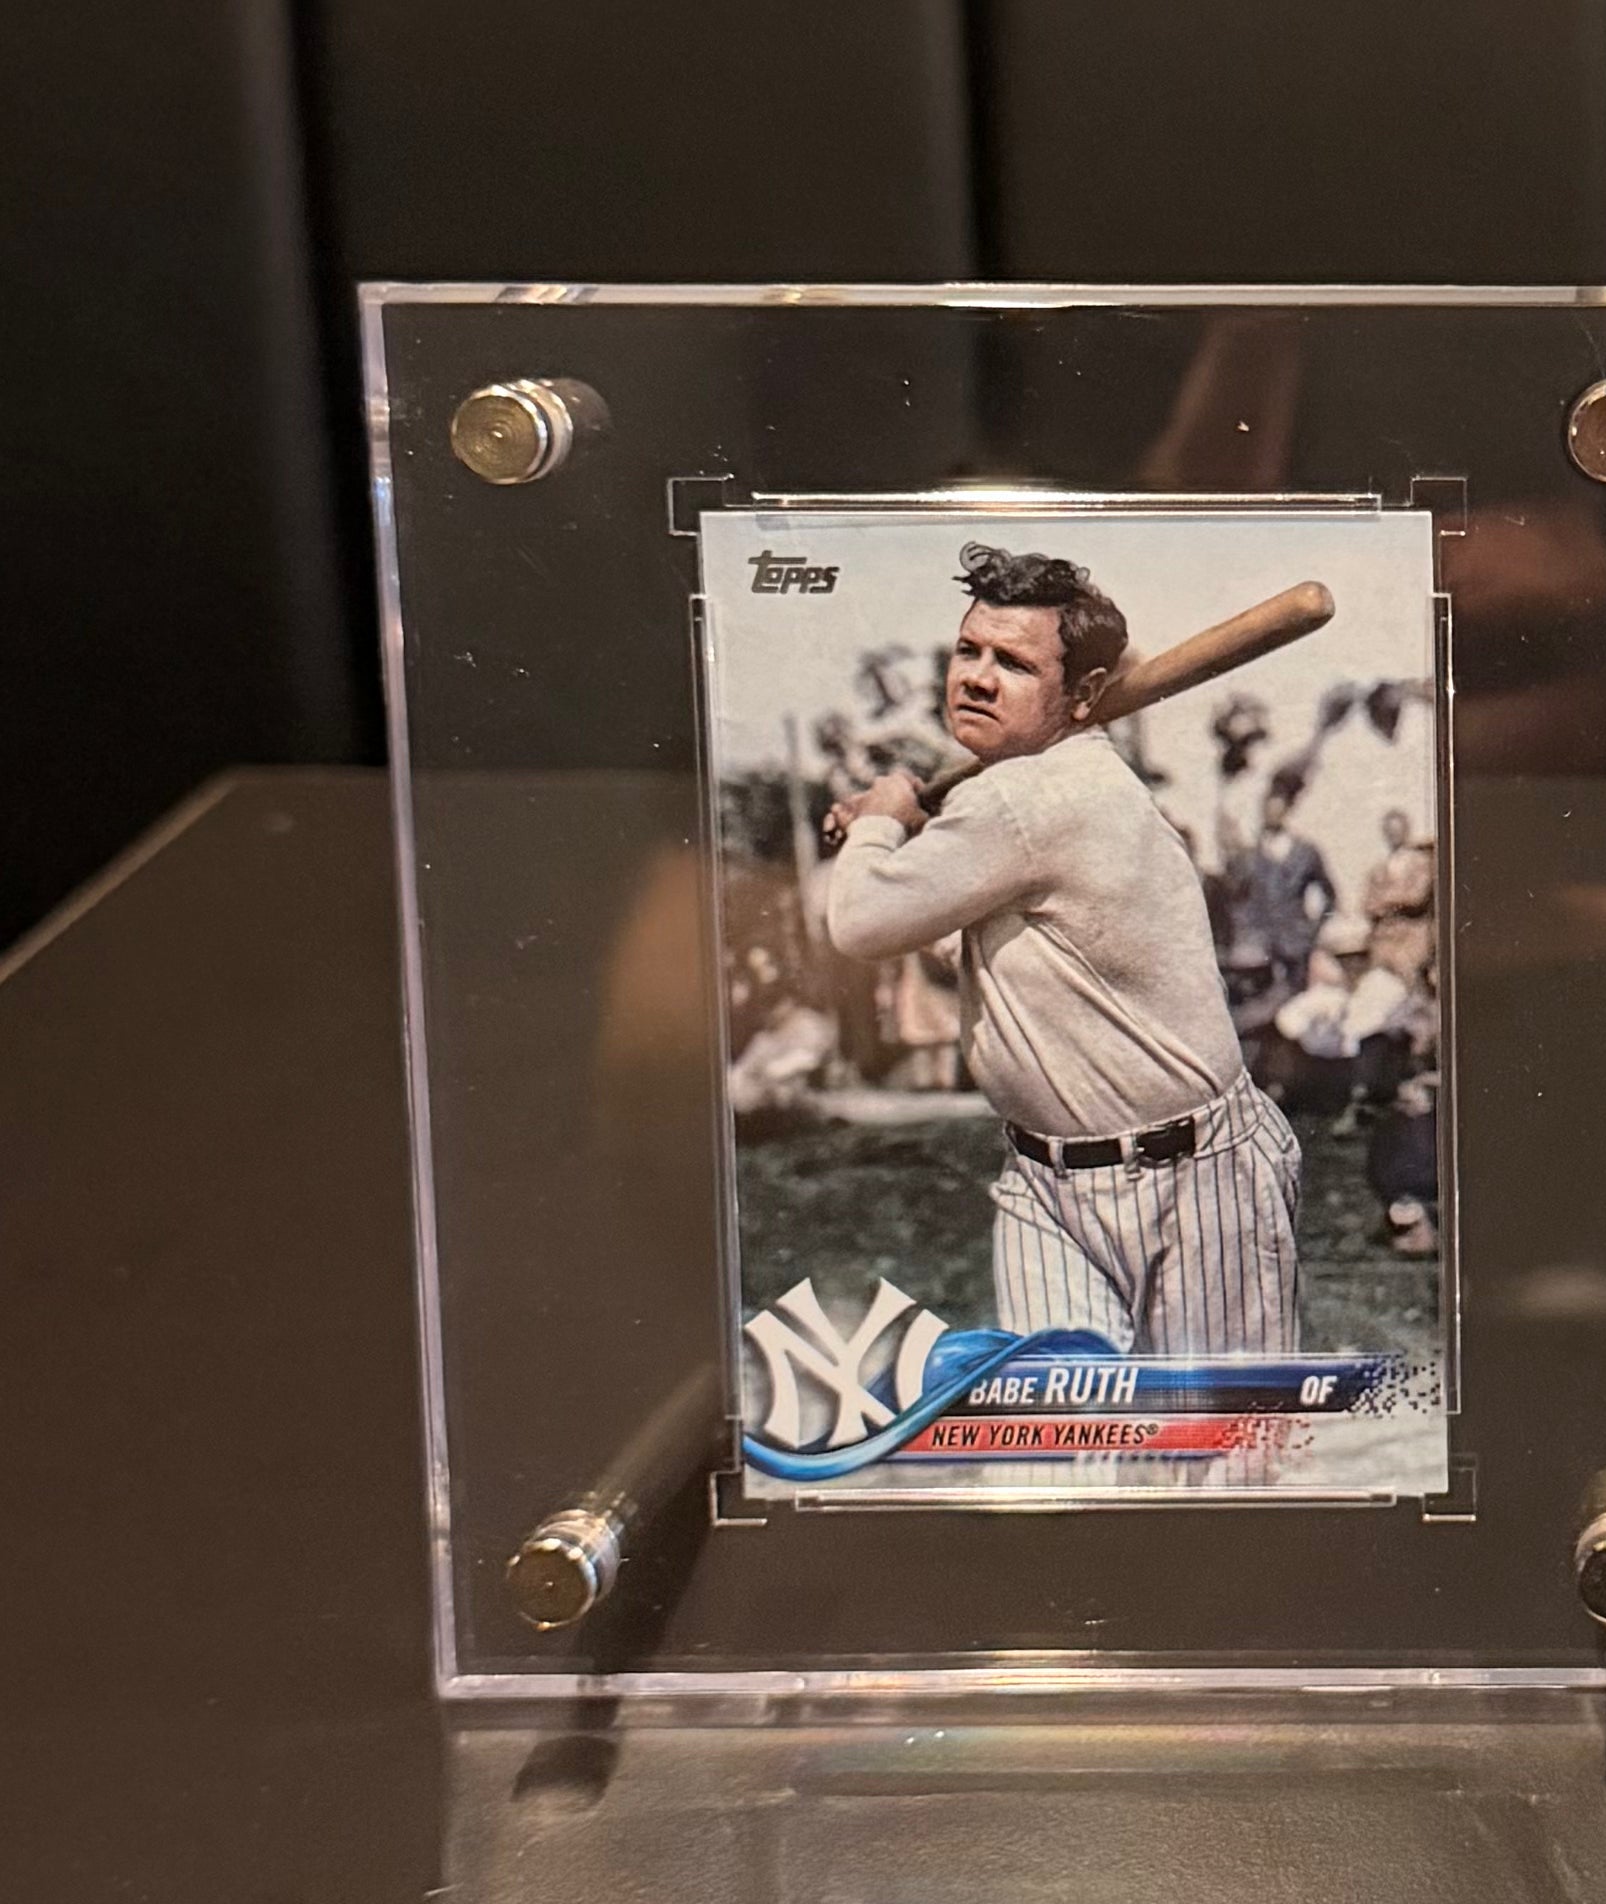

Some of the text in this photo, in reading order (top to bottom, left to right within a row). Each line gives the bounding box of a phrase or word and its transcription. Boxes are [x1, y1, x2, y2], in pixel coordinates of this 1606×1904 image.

[968, 1366, 1139, 1405] BABE RUTH
[1301, 1375, 1336, 1404] OF
[931, 1425, 981, 1447] NEW
[989, 1424, 1045, 1447] YORK
